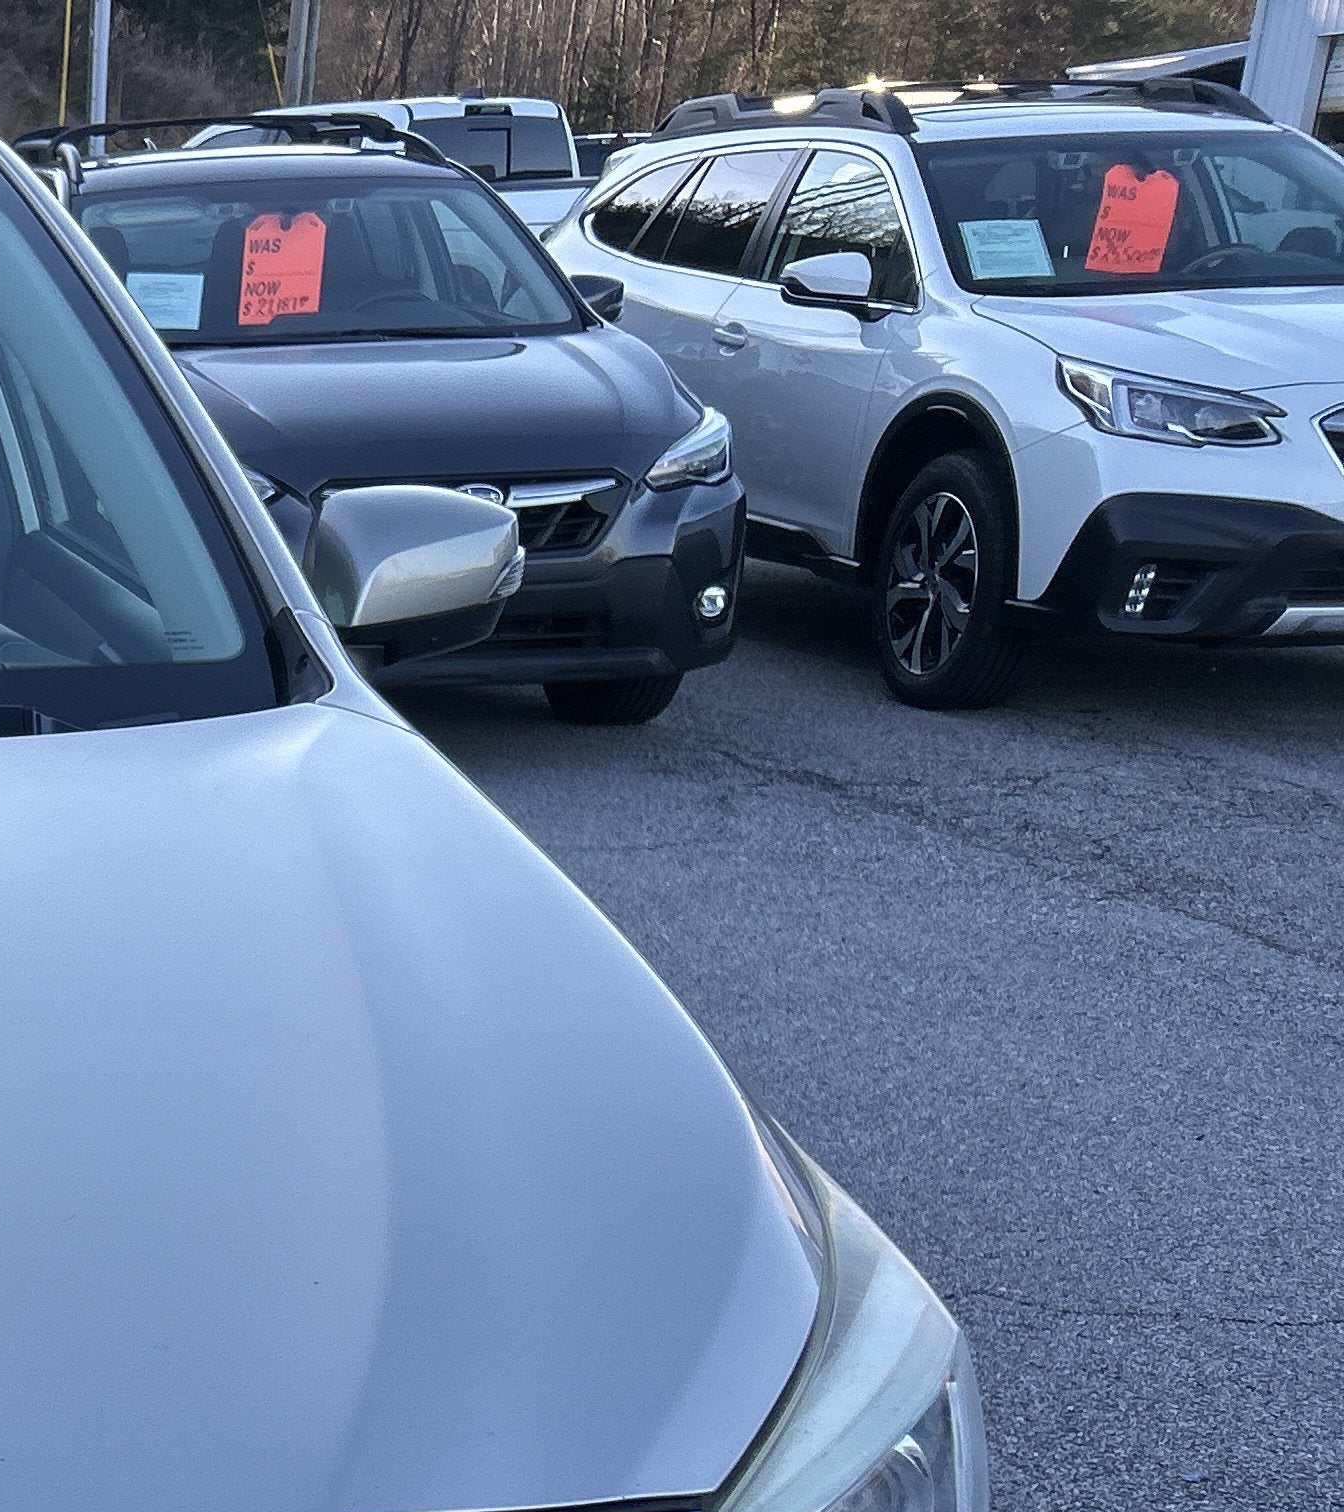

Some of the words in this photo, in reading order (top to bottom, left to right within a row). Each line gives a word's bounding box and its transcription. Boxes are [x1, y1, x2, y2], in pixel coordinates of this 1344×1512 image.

[1107, 184, 1137, 201] WAS
[1100, 205, 1111, 220] $
[1098, 227, 1132, 243] NOW
[249, 238, 281, 254] WAS
[246, 261, 256, 276] $
[245, 280, 281, 297] NOW
[242, 301, 252, 316] $
